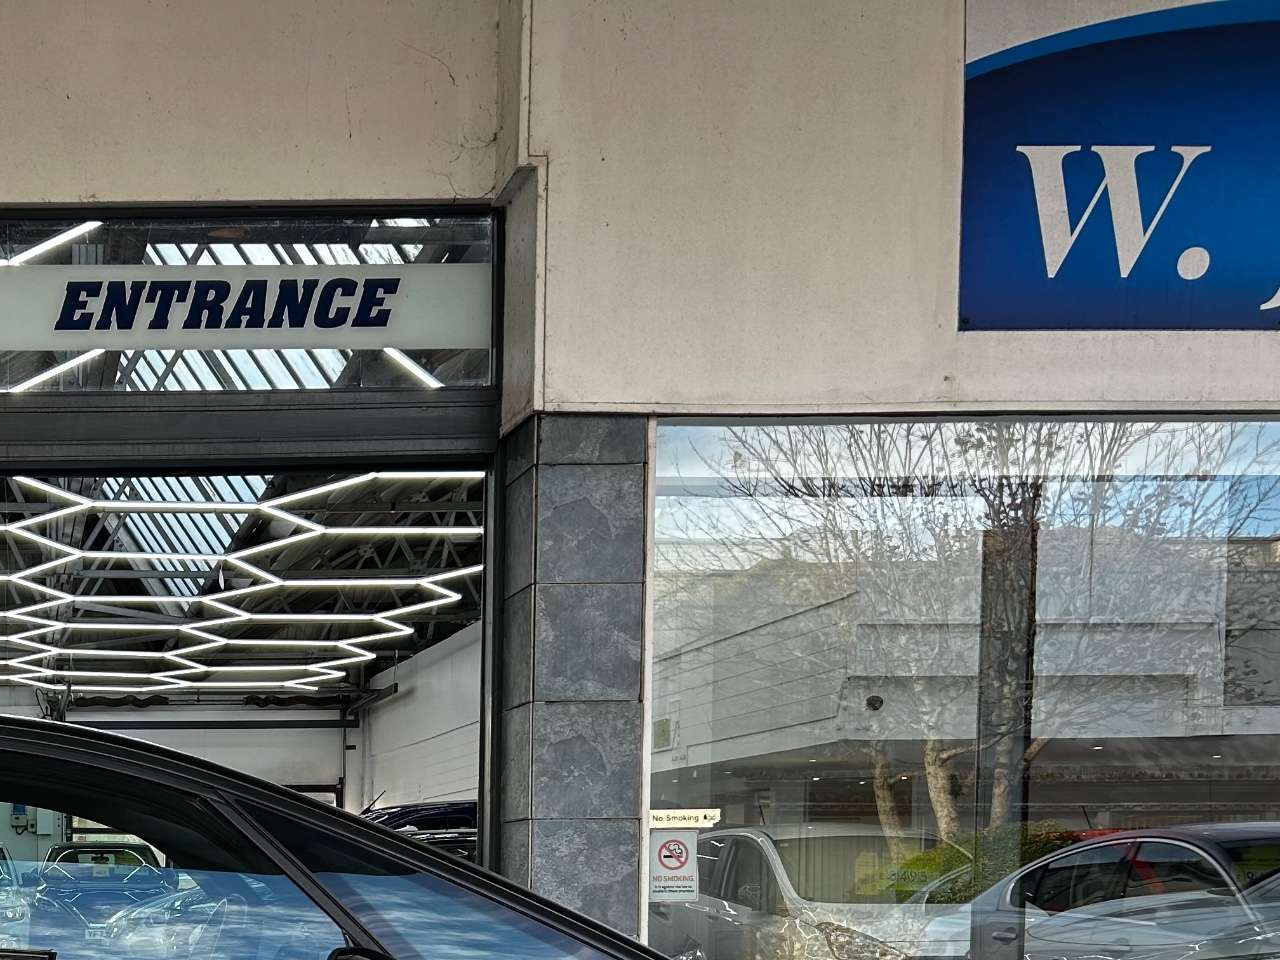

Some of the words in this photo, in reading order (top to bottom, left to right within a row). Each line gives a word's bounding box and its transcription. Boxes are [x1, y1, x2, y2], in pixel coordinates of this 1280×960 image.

[1016, 145, 1211, 280] W.
[54, 277, 401, 331] ENTRANCE
[652, 814, 663, 822] No
[666, 814, 699, 823] Smoking
